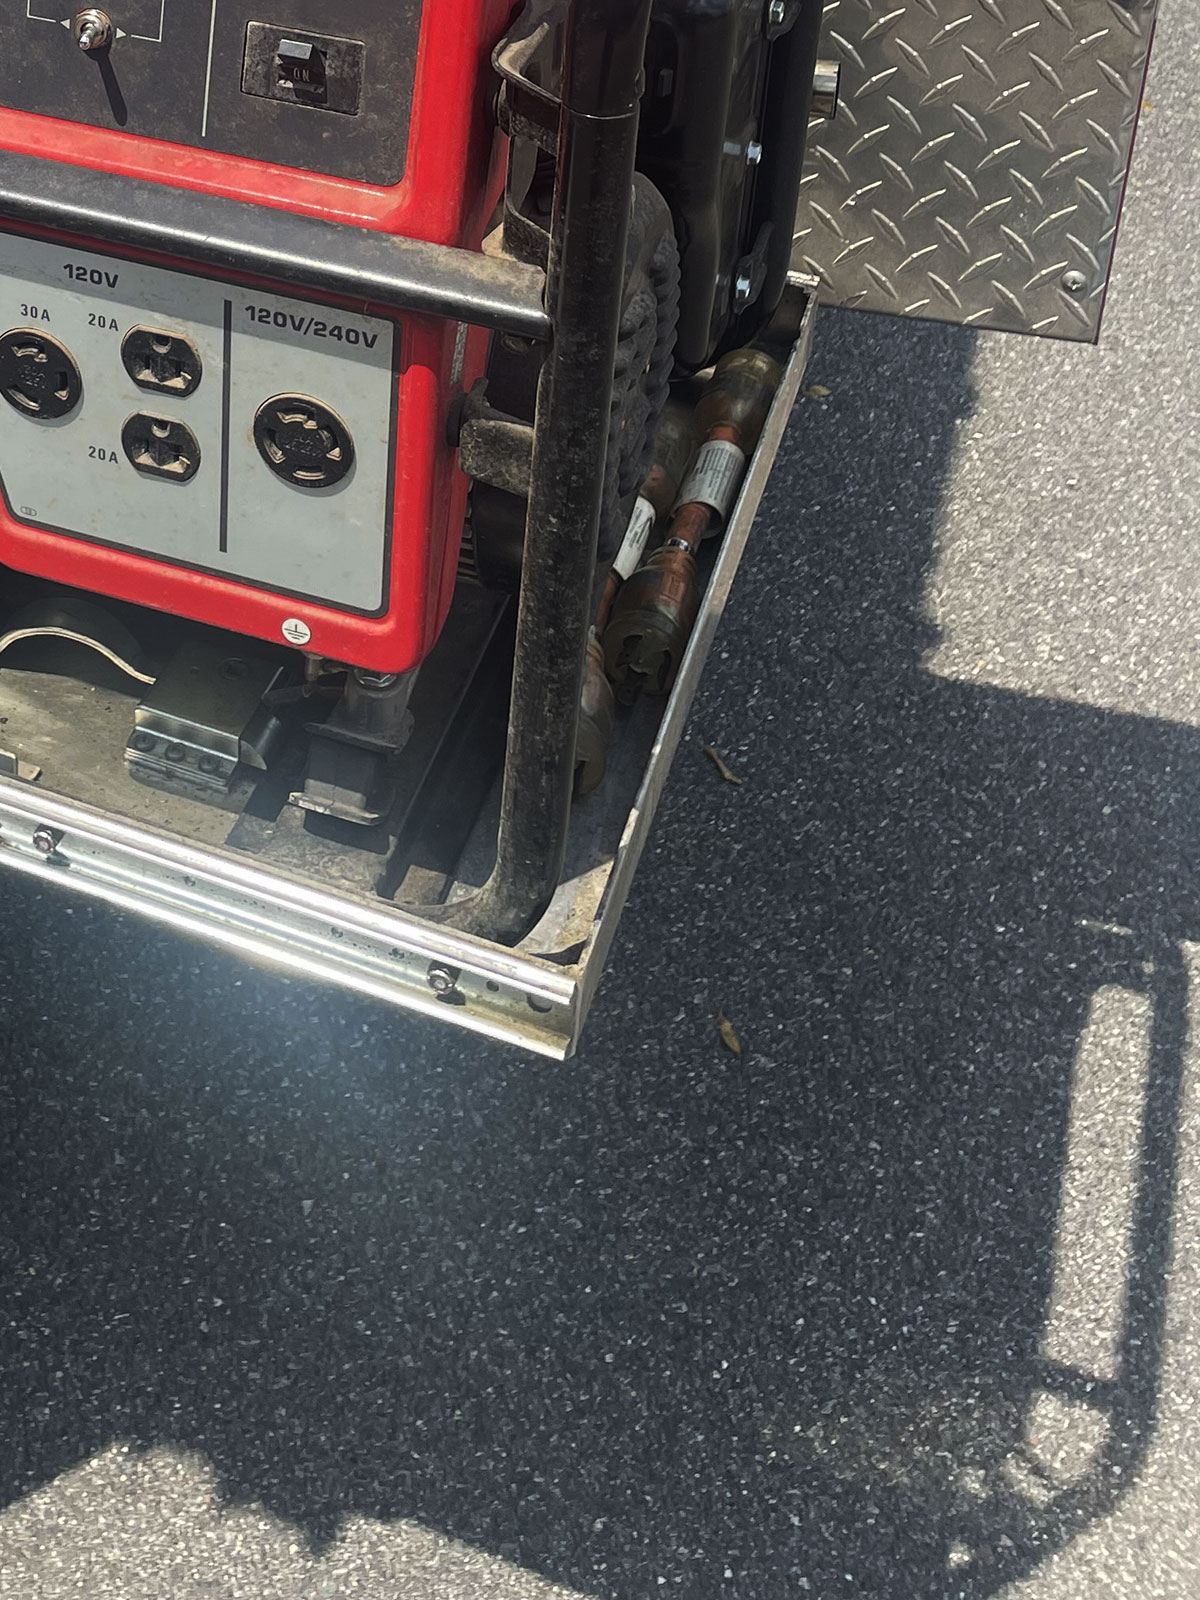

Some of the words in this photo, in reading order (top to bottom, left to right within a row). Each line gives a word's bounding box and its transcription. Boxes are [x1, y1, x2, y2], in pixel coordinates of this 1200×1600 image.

[293, 67, 310, 82] ON
[62, 262, 119, 289] 120V
[243, 304, 379, 350] 120V/240V
